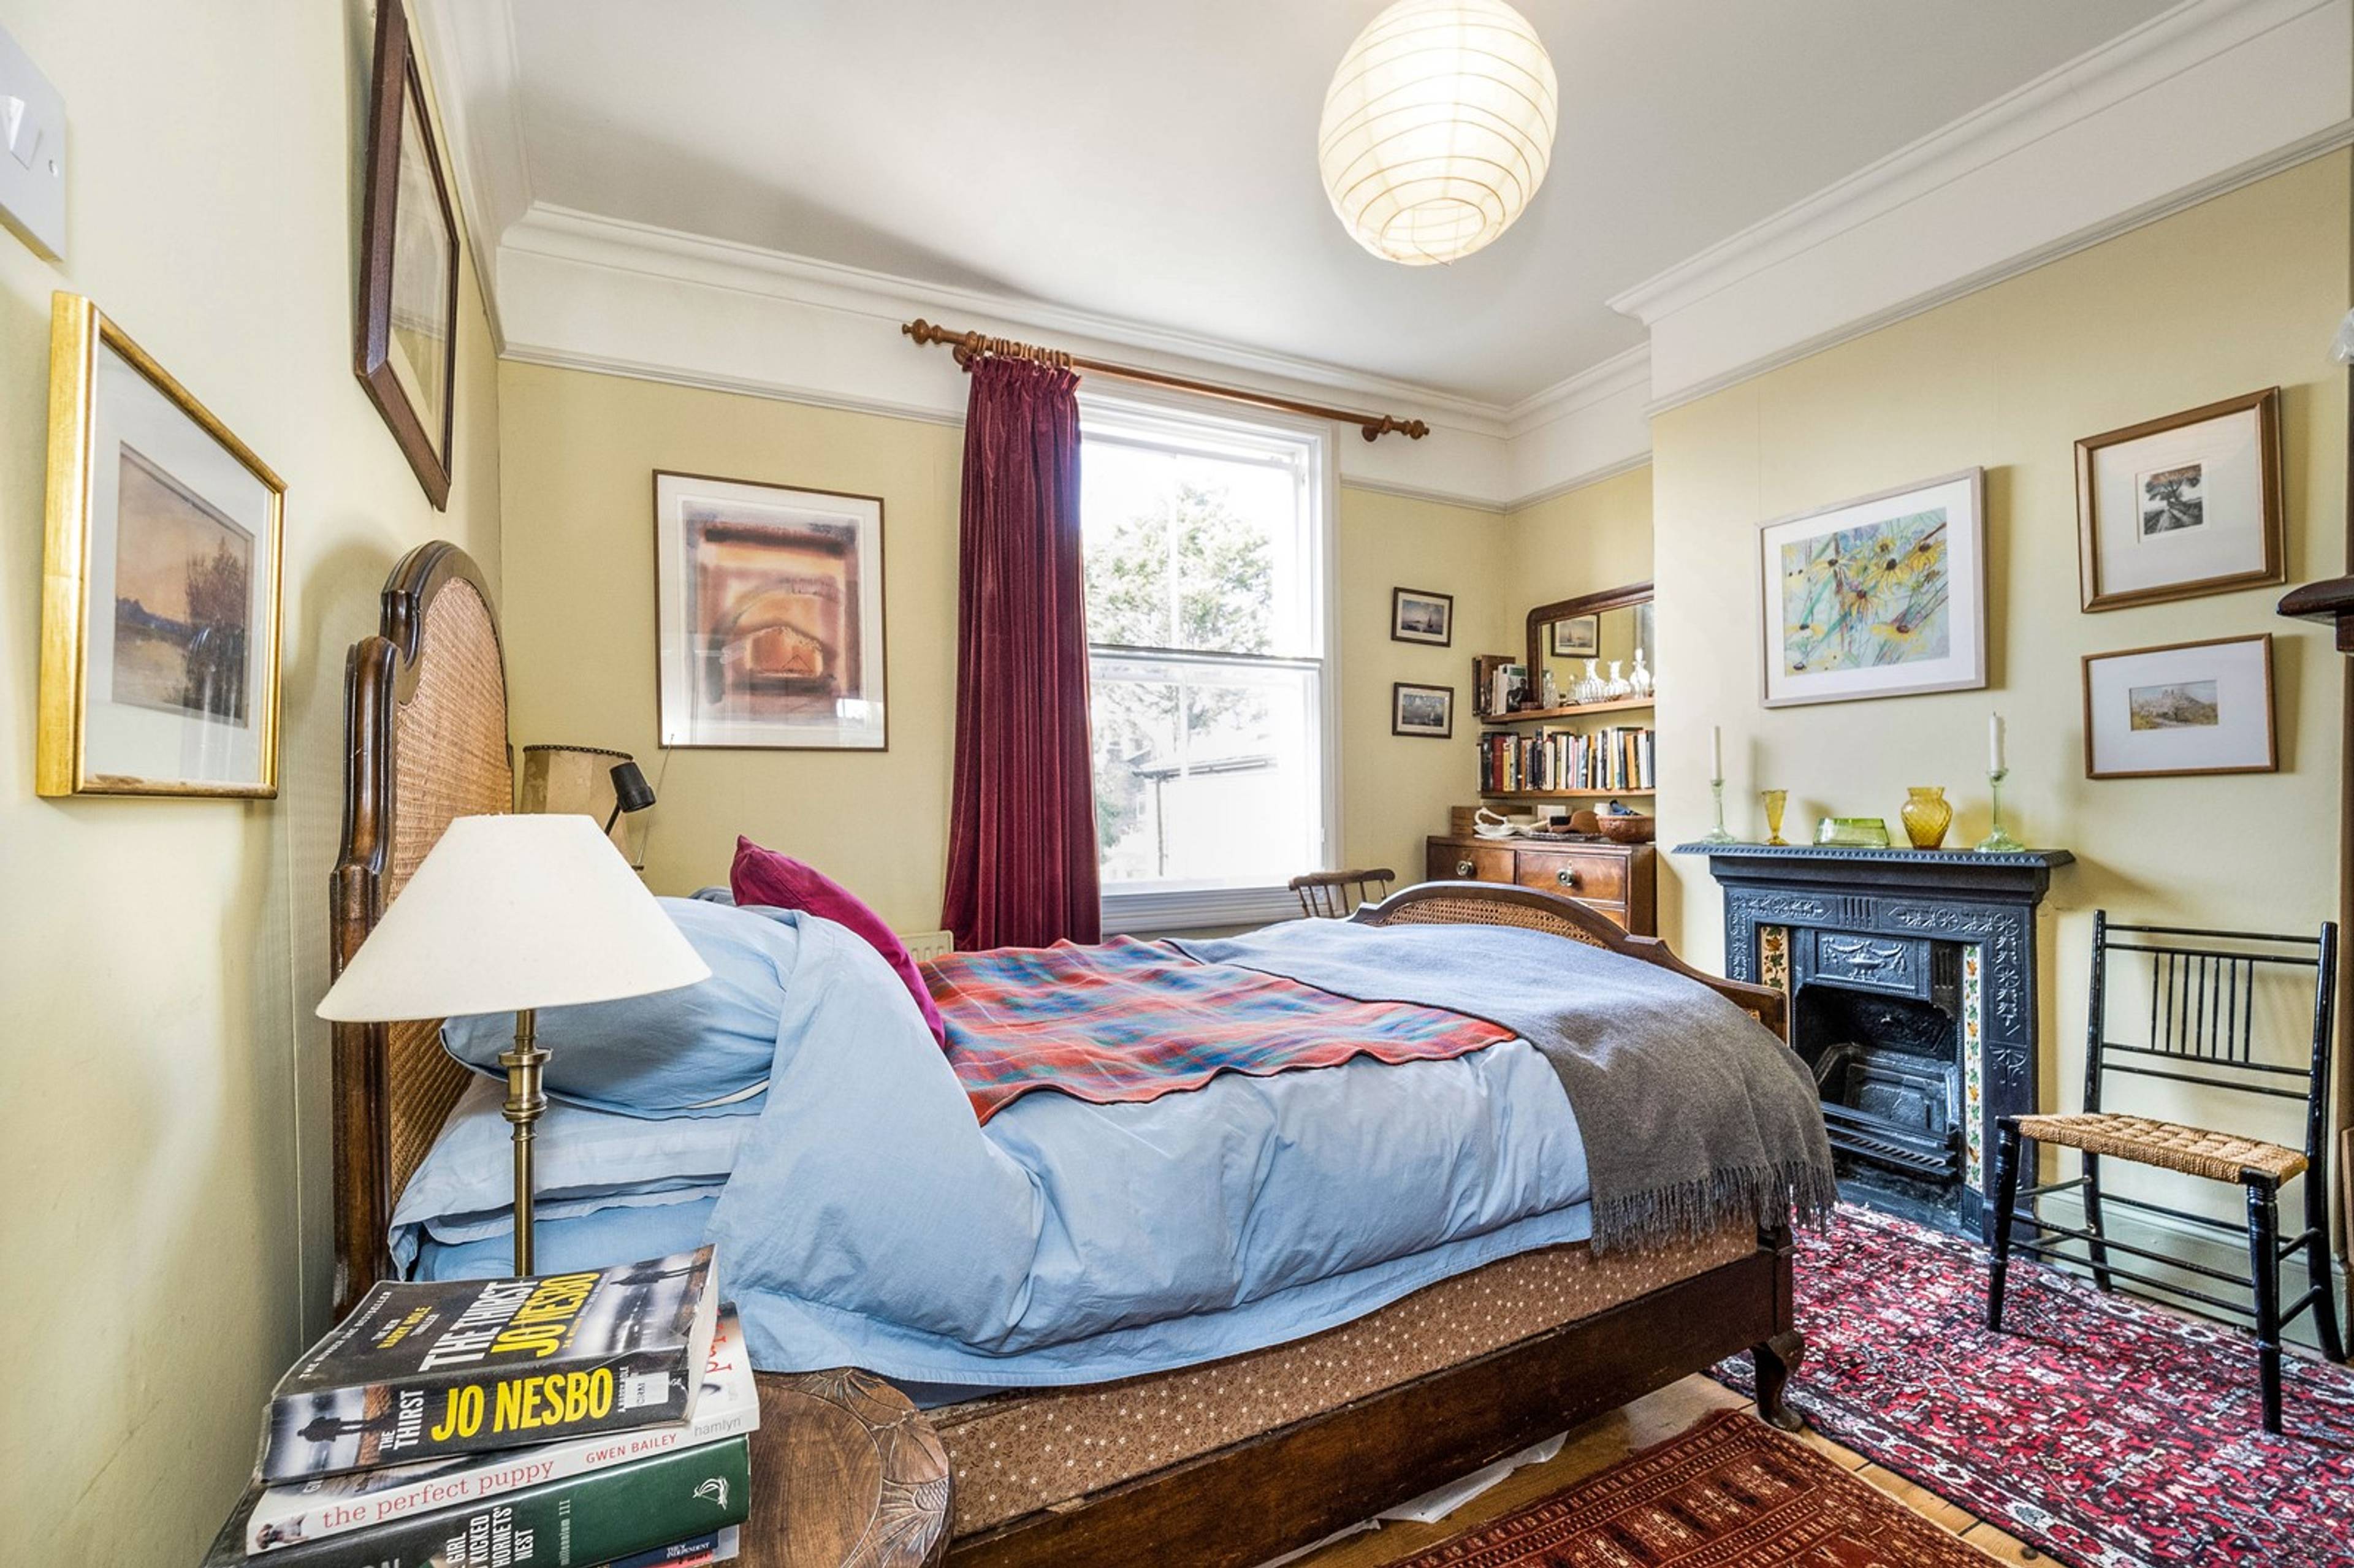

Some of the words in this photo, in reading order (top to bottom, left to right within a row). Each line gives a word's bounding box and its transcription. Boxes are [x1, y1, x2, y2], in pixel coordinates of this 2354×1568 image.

[449, 1280, 538, 1331] THIRST
[509, 1273, 600, 1326] NESBO
[418, 1326, 502, 1372] THE
[491, 1324, 567, 1358] JO
[394, 1390, 424, 1450] THIRST
[431, 1385, 484, 1442] JO
[493, 1368, 613, 1433] NESBO
[695, 1417, 741, 1436] hamlyn
[378, 1429, 395, 1451] THE
[586, 1447, 626, 1464] GWEN
[631, 1433, 677, 1453] BAILEY
[322, 1506, 367, 1528] the
[378, 1479, 469, 1520] perfect
[479, 1460, 555, 1495] puppy
[446, 1531, 467, 1564] GIRL
[470, 1514, 489, 1564] KICKED
[514, 1529, 533, 1562] NEST
